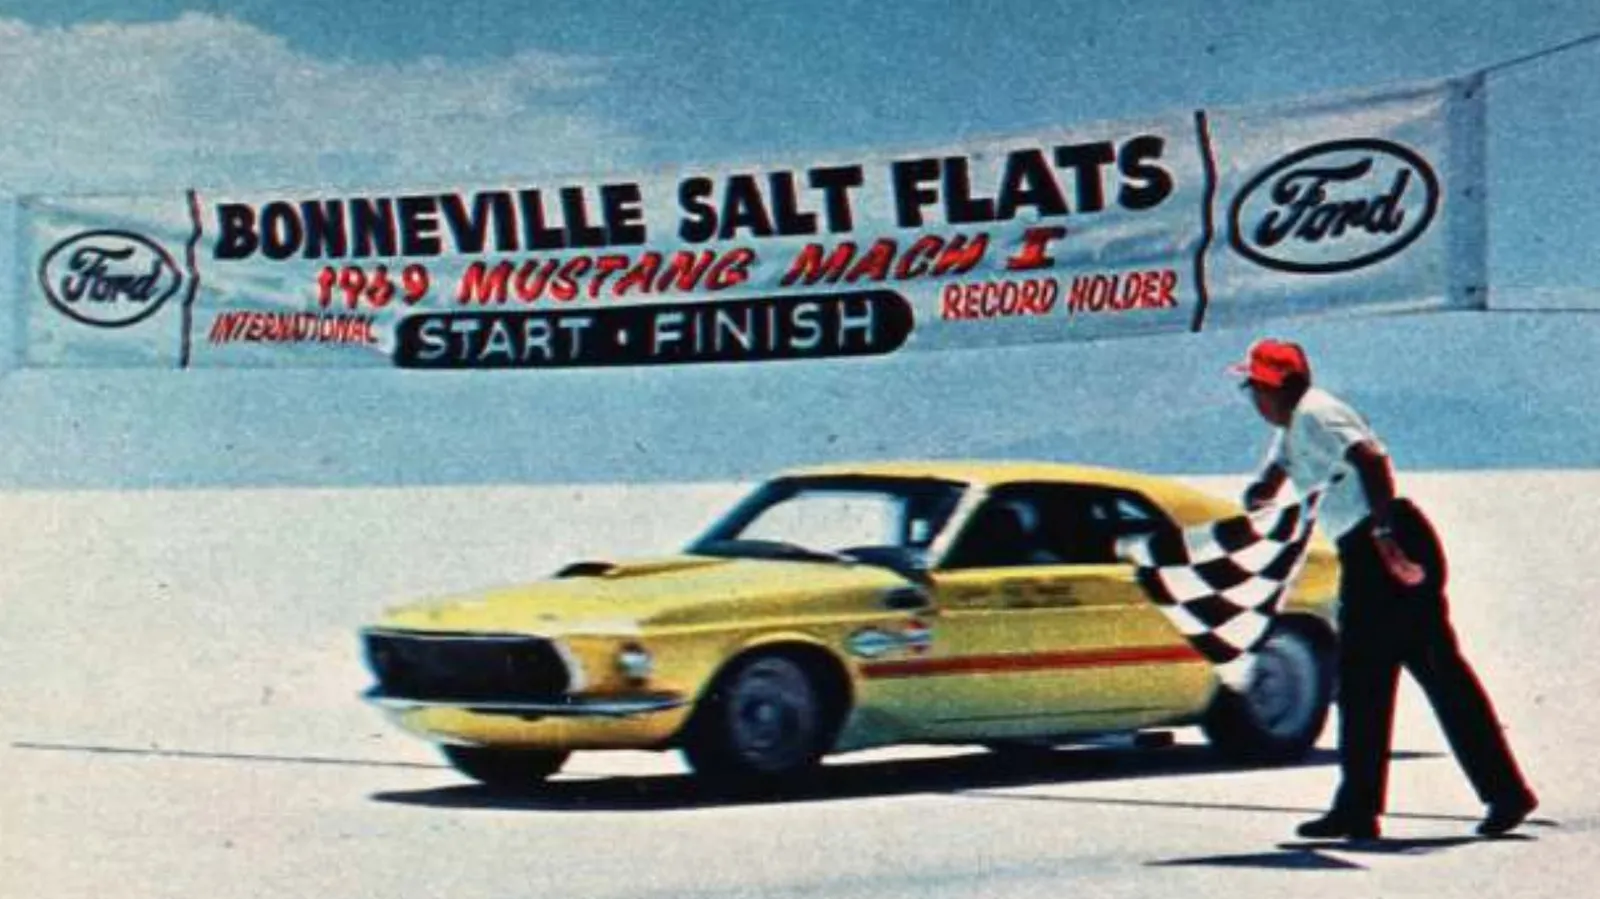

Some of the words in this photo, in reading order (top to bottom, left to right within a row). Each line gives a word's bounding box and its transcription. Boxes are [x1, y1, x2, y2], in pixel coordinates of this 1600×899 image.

[214, 183, 646, 259] BONNEVILLE
[678, 164, 864, 244] SALT
[892, 134, 1173, 228] FLATS
[1256, 158, 1410, 247] Ford
[60, 246, 162, 303] Ford
[317, 263, 430, 308] 1969
[459, 247, 757, 305] MUSTANG
[781, 231, 990, 288] MACH
[941, 276, 1060, 321] RECORD
[1069, 269, 1180, 315] HOLDER
[209, 311, 379, 345] INTERNATIONAL
[416, 317, 592, 361] START
[652, 300, 874, 355] FINISH
